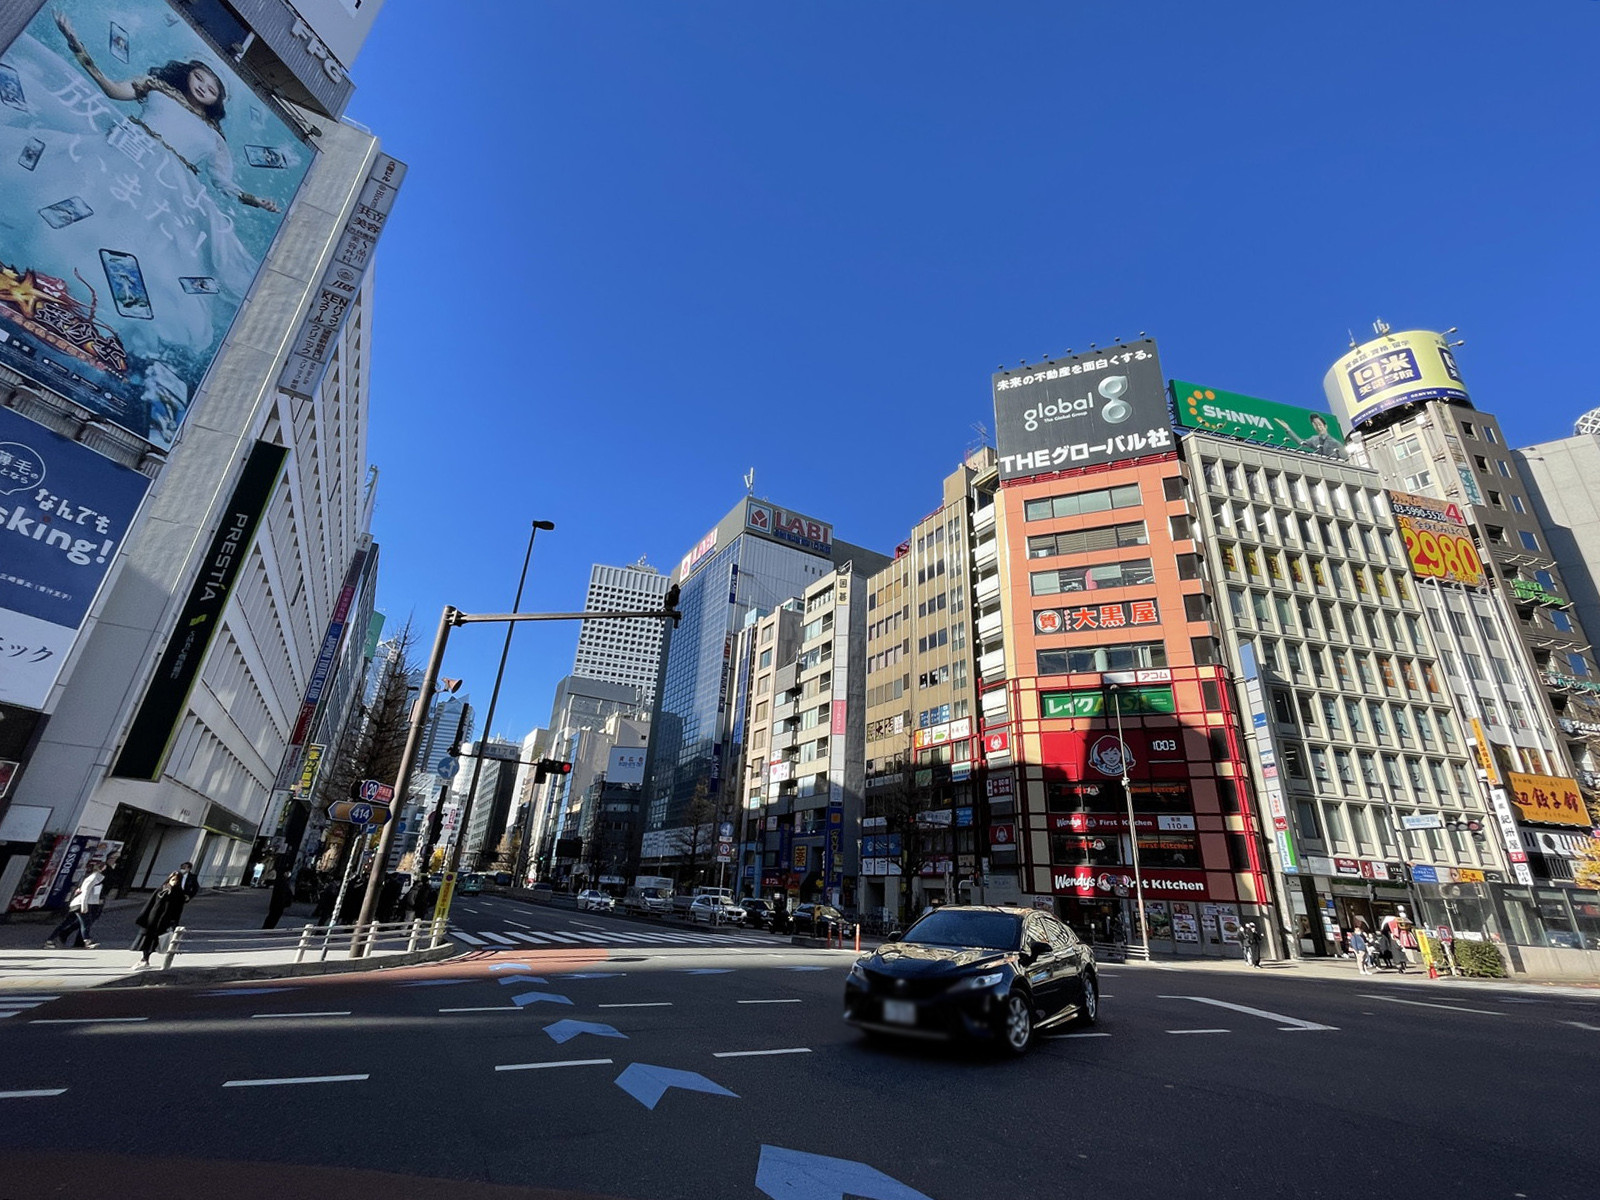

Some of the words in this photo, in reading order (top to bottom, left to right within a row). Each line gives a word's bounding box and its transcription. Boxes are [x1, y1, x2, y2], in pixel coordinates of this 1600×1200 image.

[292, 18, 341, 83] FPG
[49, 76, 234, 231] 放置しよう
[322, 291, 348, 307] KEN
[997, 349, 1153, 391] 未来の不動産を面白くする。
[1024, 391, 1094, 431] global
[1055, 414, 1071, 422] Global
[1072, 411, 1088, 419] Group
[1202, 404, 1274, 430] SHINWA
[999, 427, 1171, 473] THEグローバル社
[35, 488, 110, 534] なんでも
[774, 509, 831, 544] LABI
[691, 530, 716, 564] LABI
[1401, 527, 1482, 579] 2980
[1039, 613, 1058, 629] 質
[1073, 600, 1158, 631] 大黒屋
[308, 681, 321, 699] CLUB
[1141, 671, 1168, 680] アコム
[367, 783, 378, 796] 20
[352, 807, 370, 819] 414
[61, 852, 77, 875] BOSS
[1054, 872, 1096, 891] Wendy's
[1152, 879, 1204, 891] Kitchen
